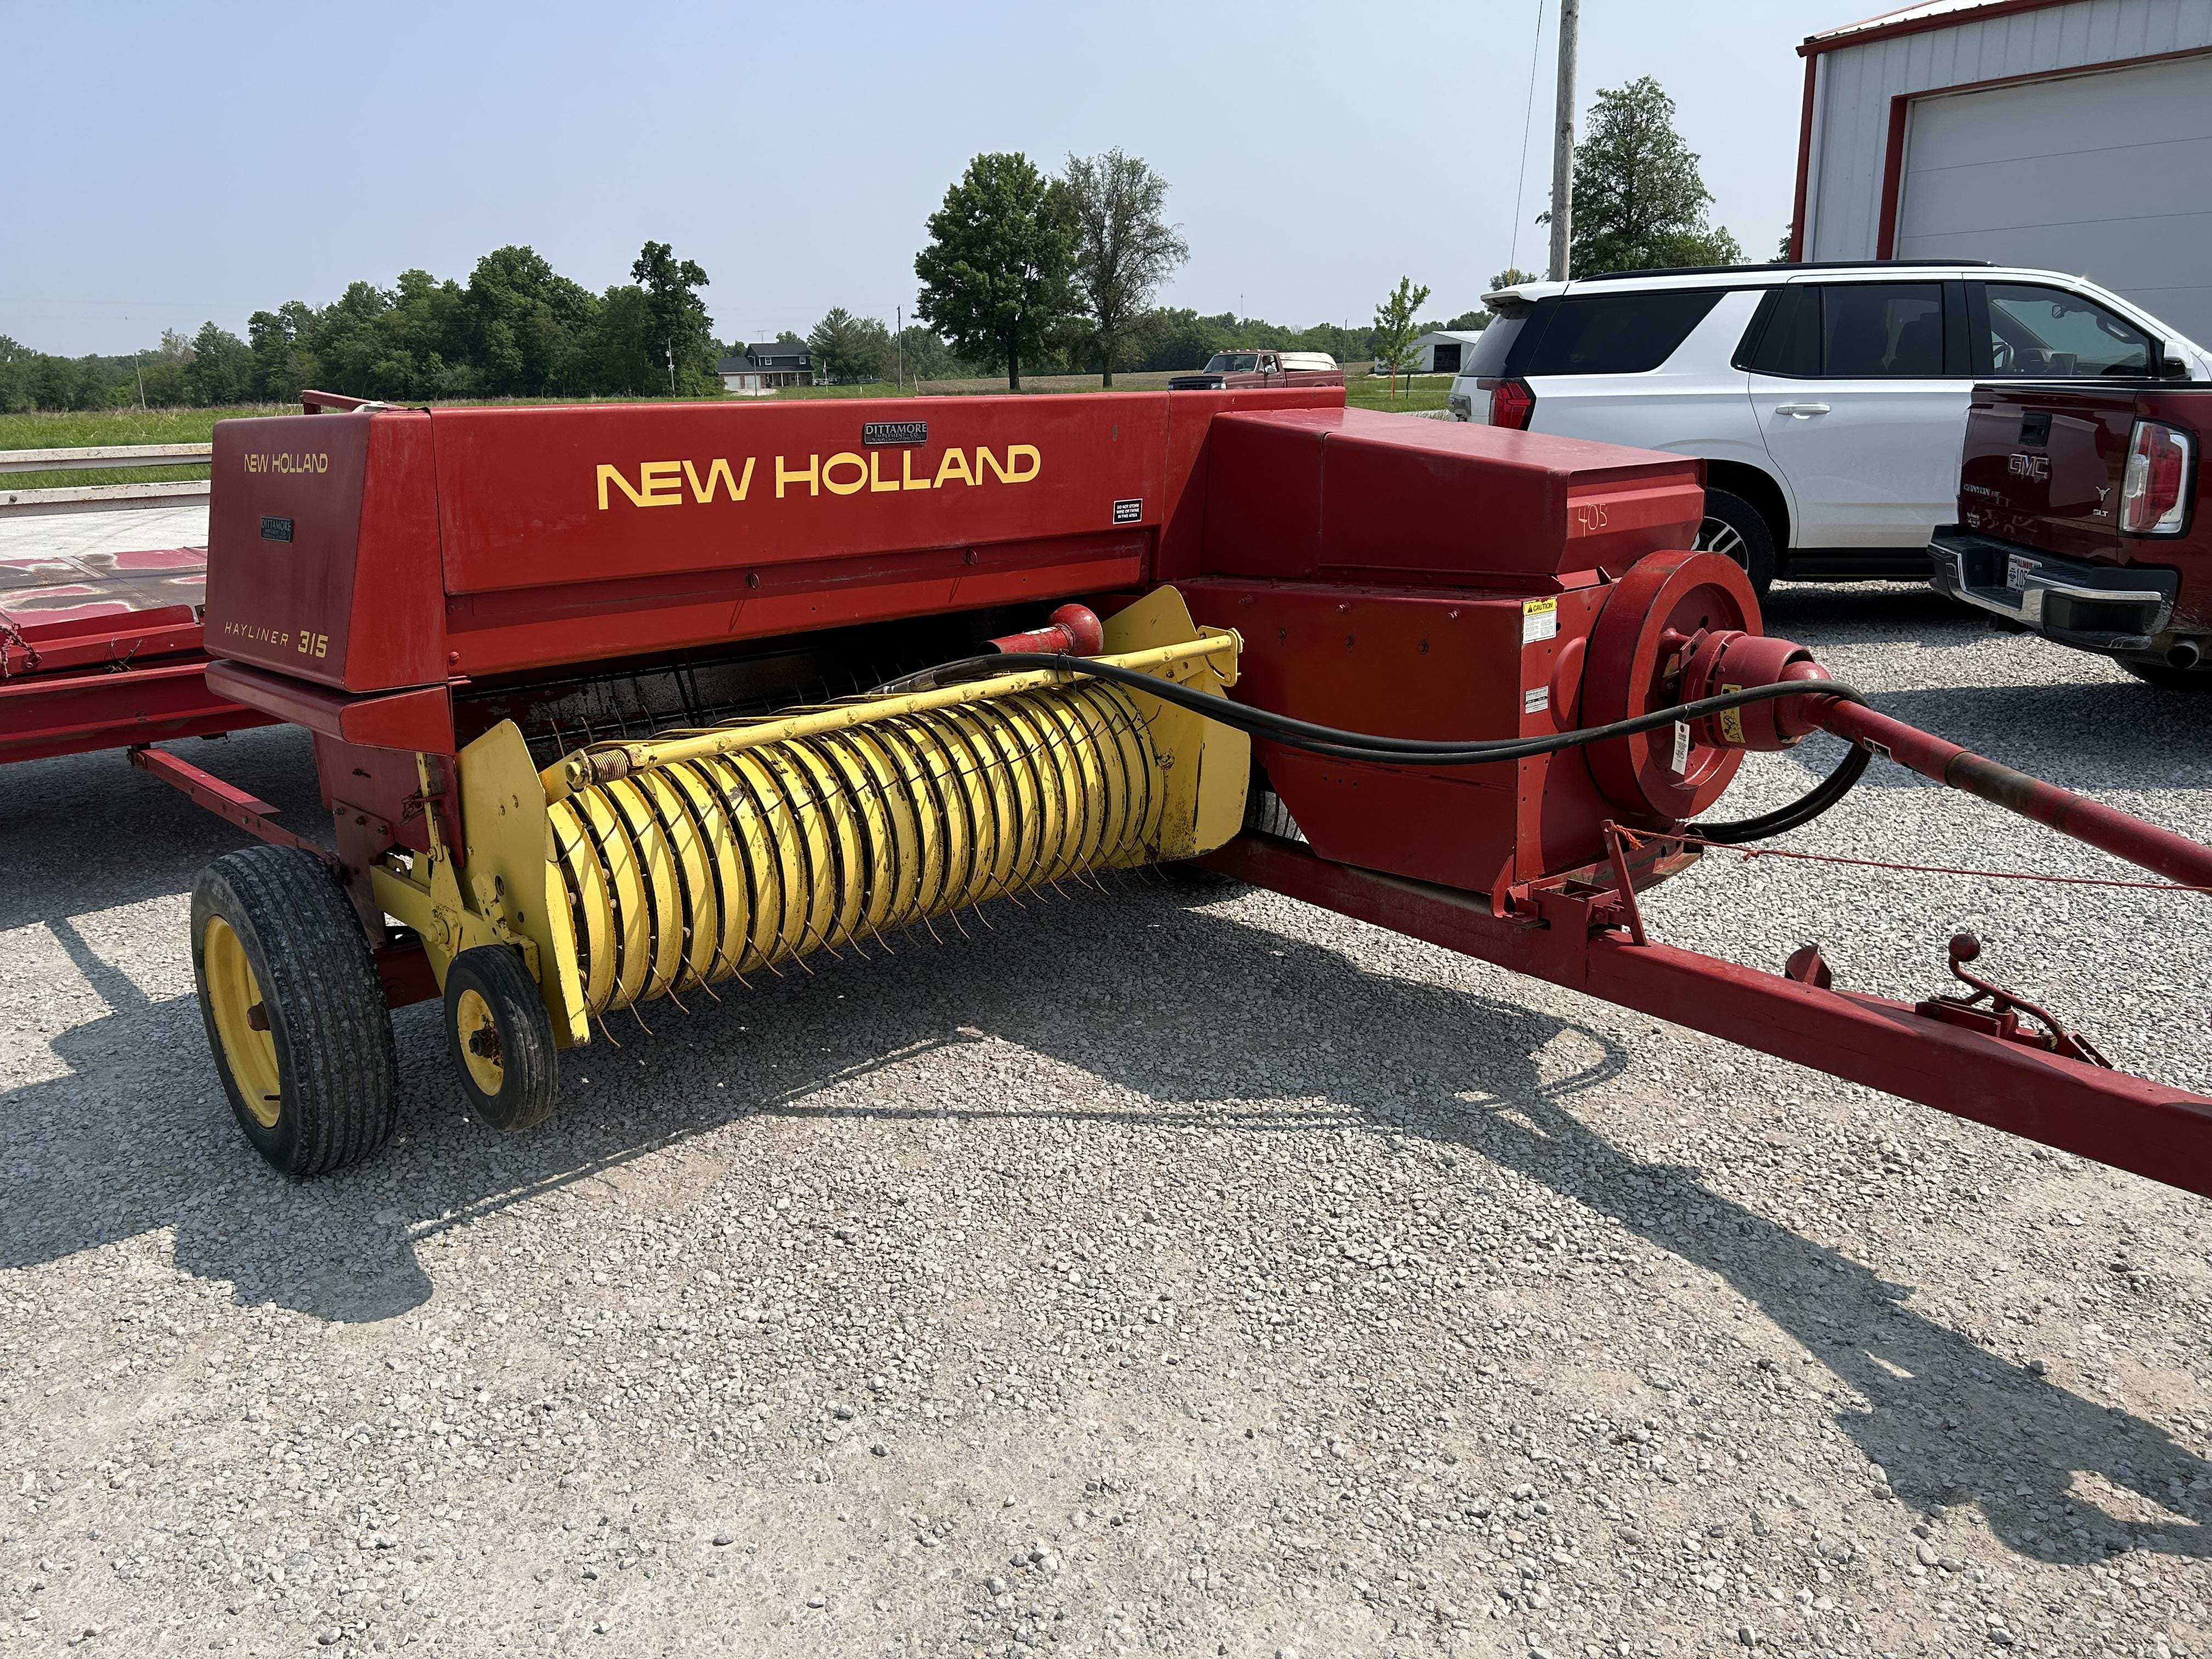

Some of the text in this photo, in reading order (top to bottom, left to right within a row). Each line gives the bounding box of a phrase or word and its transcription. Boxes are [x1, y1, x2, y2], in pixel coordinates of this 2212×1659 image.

[866, 424, 927, 435] DITTAMORE
[244, 453, 328, 473] NEW HOLLAND
[2008, 453, 2050, 479] GMC
[596, 444, 1041, 510] NEW HOLLAND
[1578, 502, 1607, 537] 405
[2092, 509, 2109, 517] SLT
[262, 518, 291, 532] DITTAMORE
[1533, 602, 1553, 612] CAUTION
[224, 621, 329, 658] HAYLINER 315
